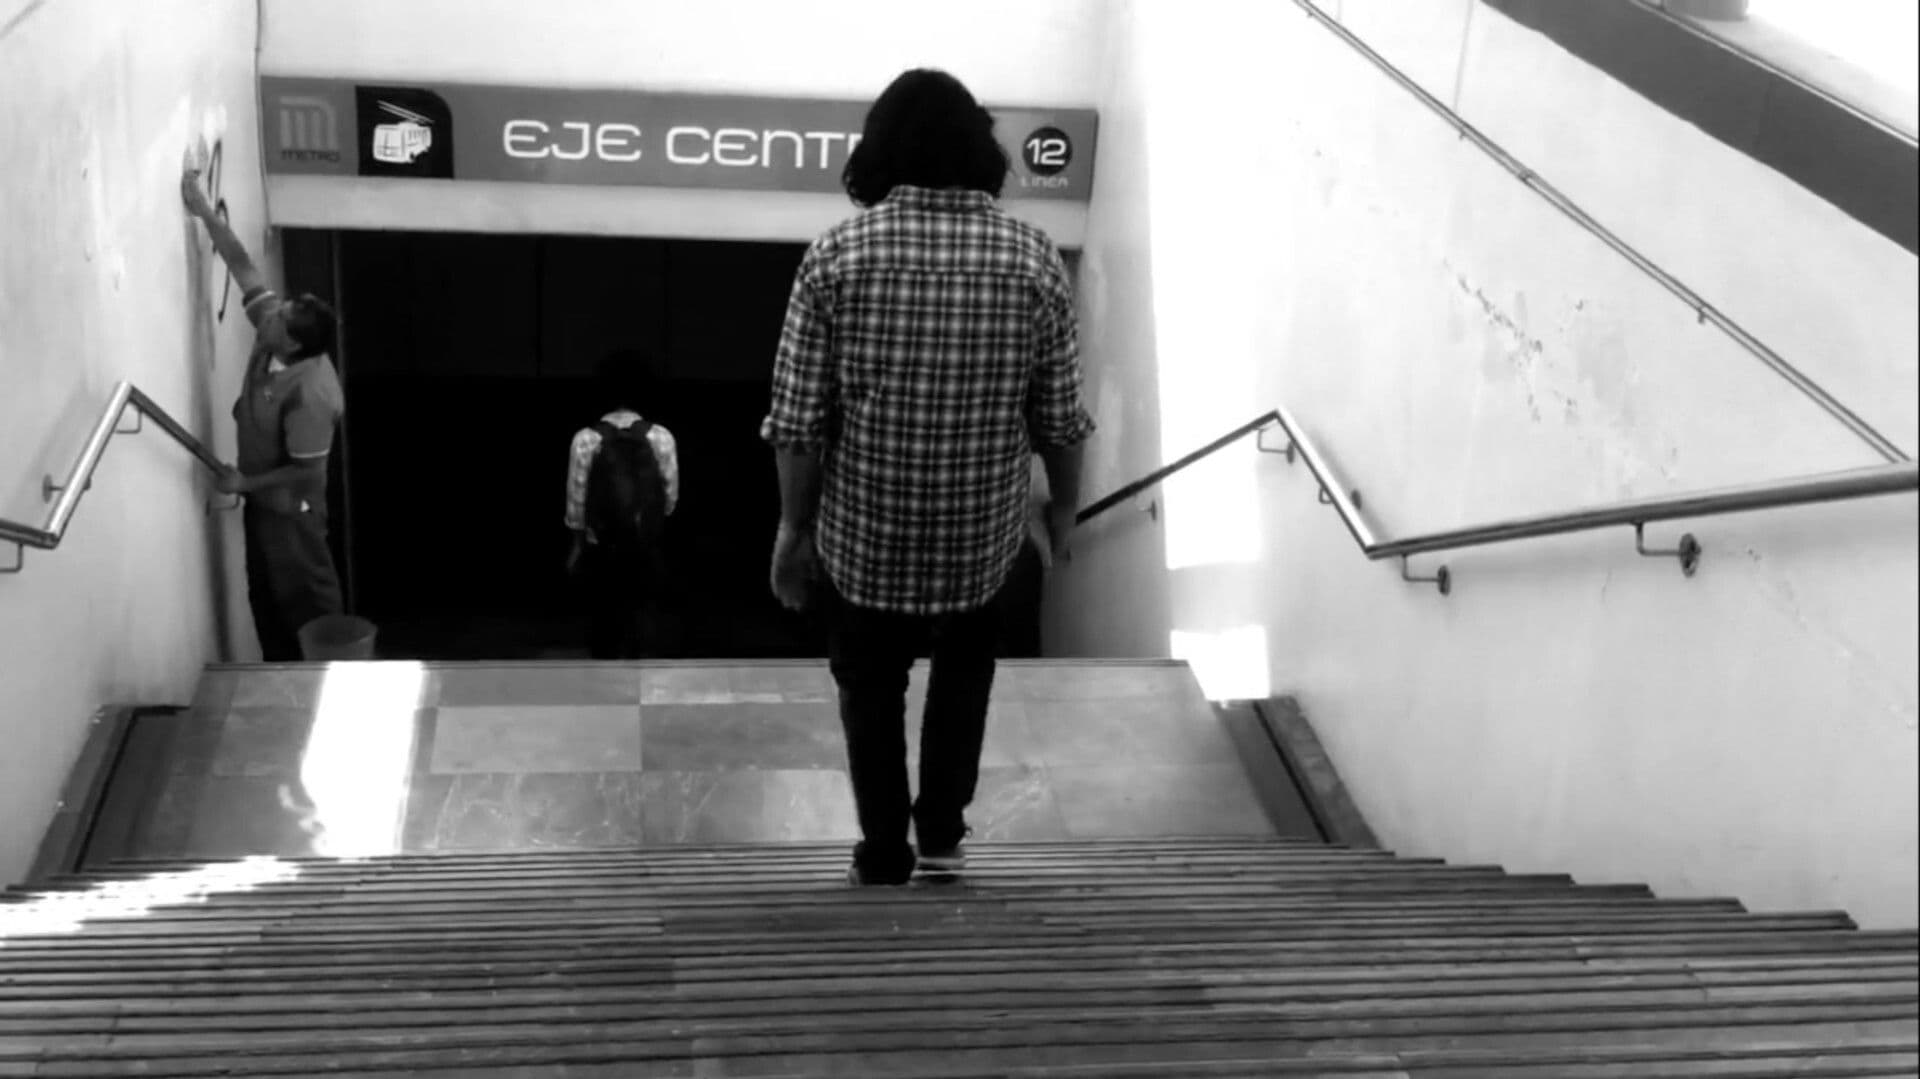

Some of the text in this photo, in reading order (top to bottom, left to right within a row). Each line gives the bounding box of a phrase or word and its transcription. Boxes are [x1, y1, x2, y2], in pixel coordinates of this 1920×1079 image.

[281, 150, 341, 163] METRO
[503, 120, 863, 169] EJE CENT
[1026, 138, 1067, 165] 12
